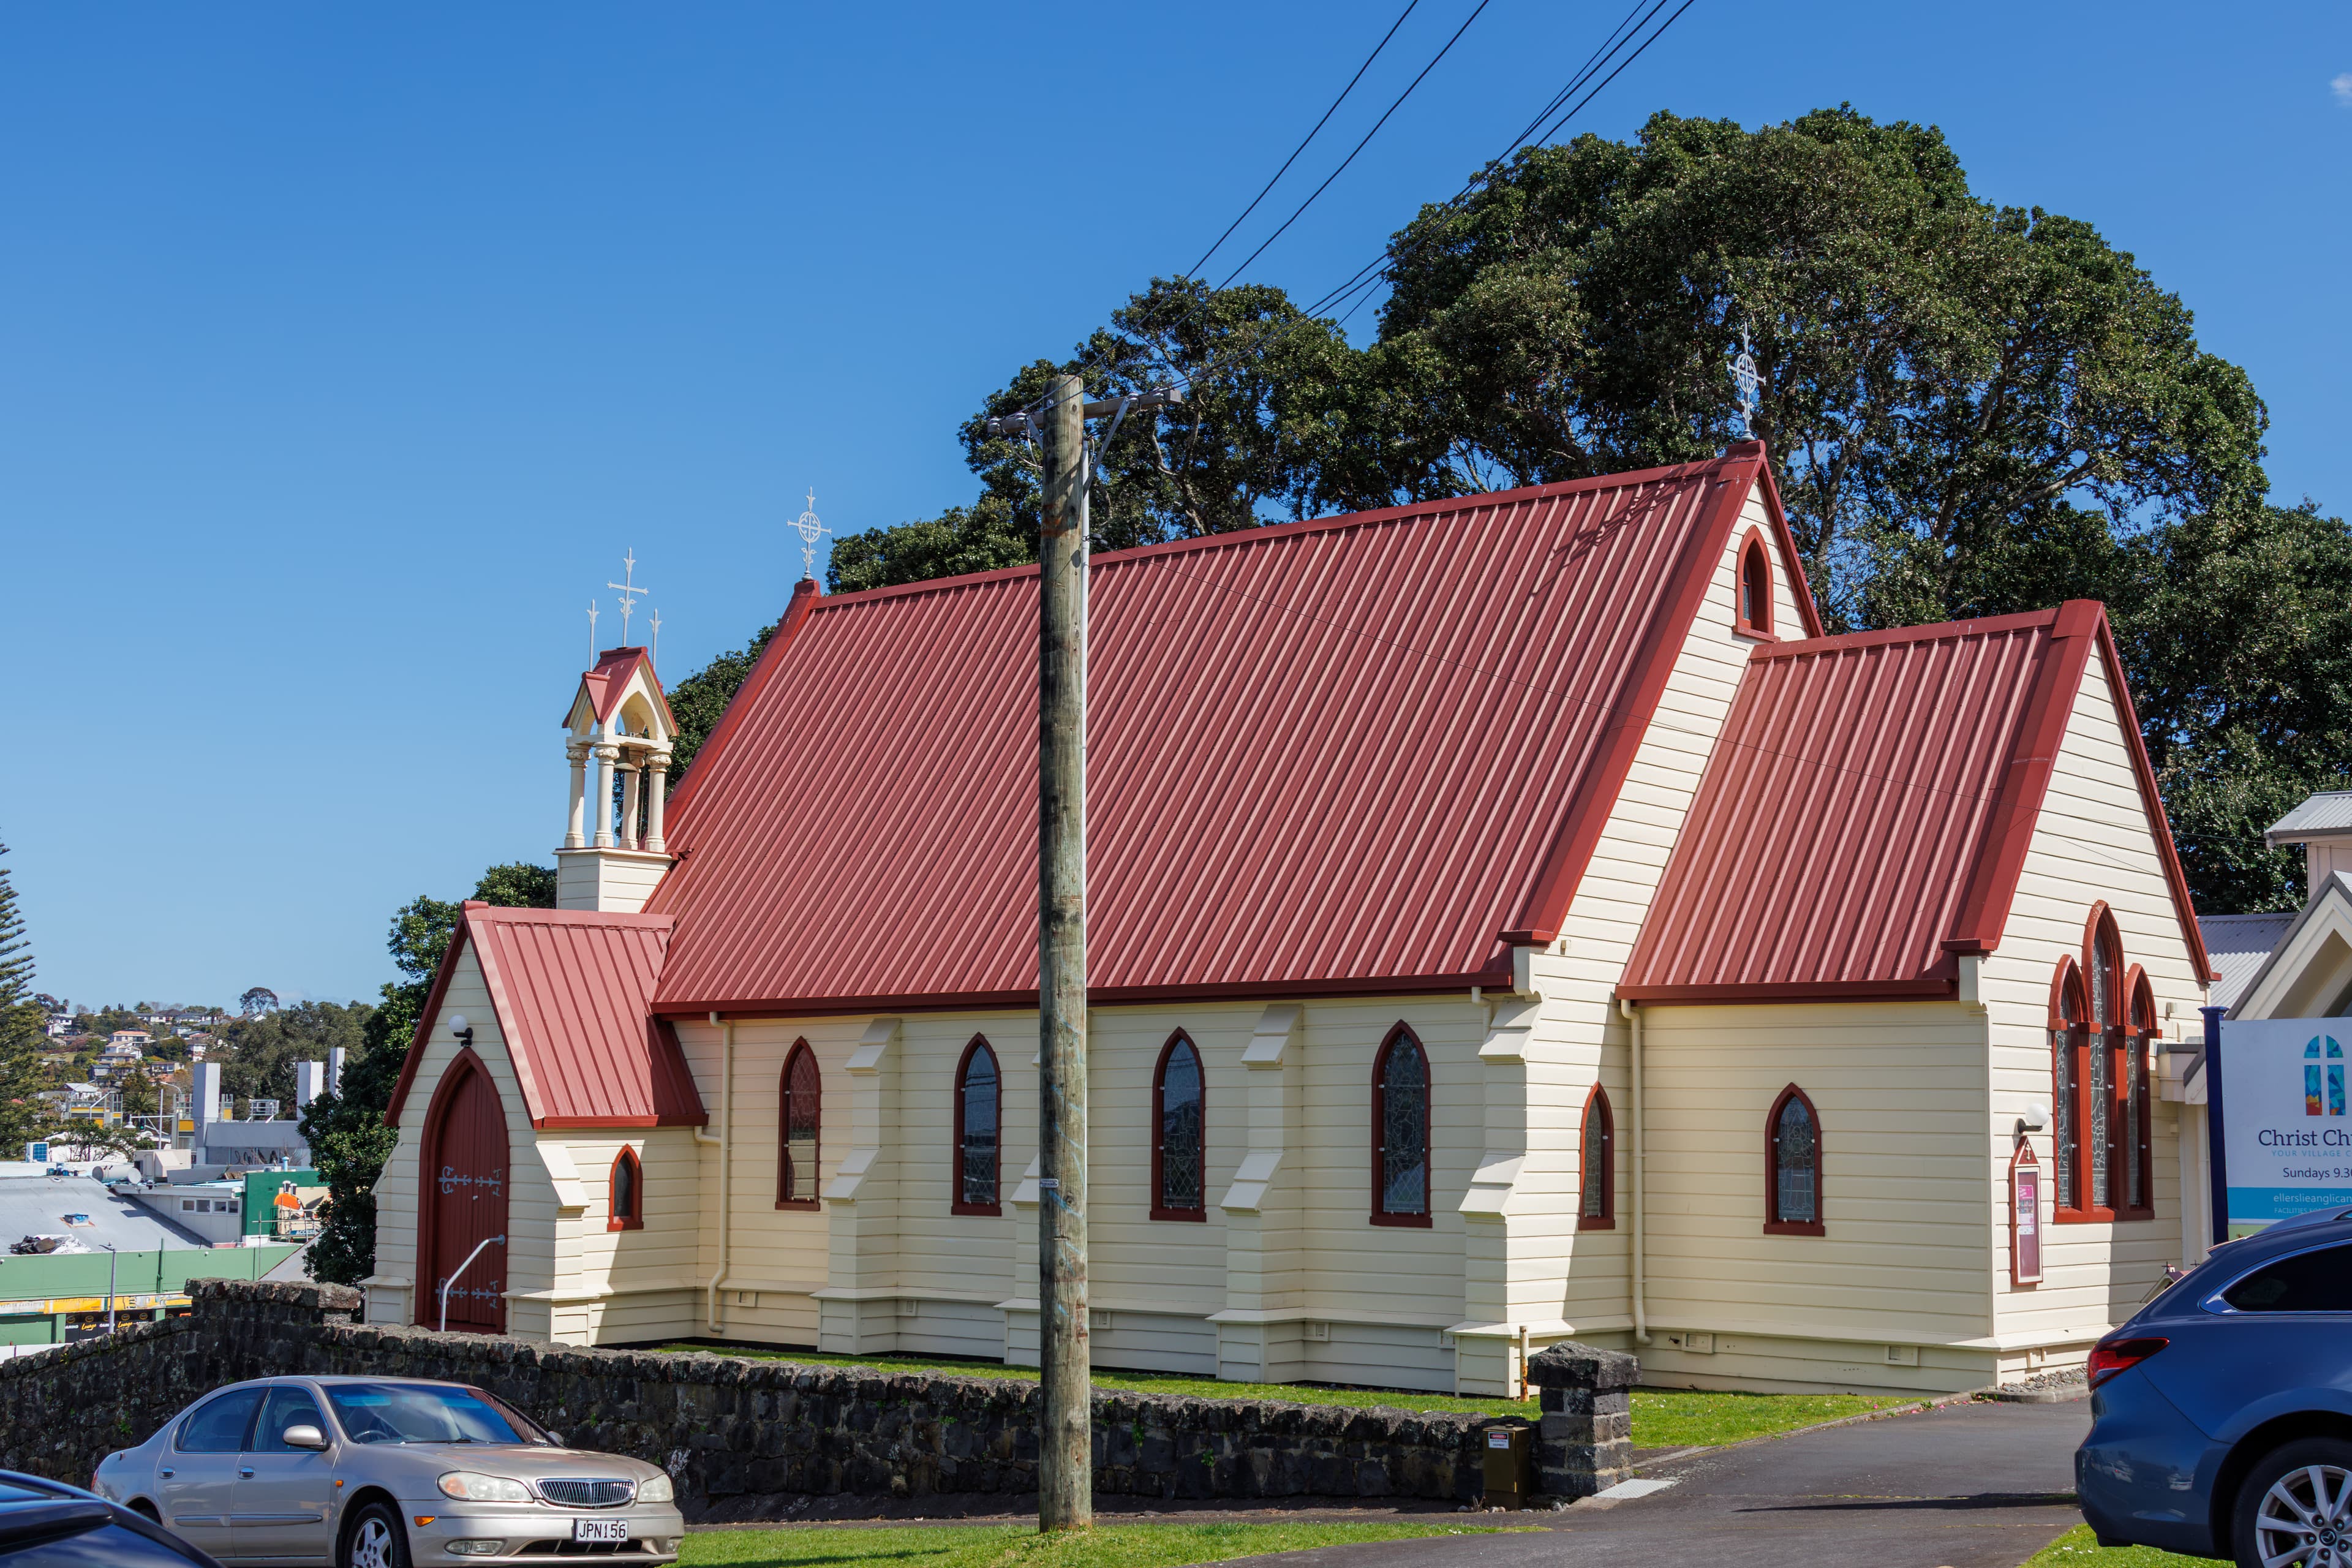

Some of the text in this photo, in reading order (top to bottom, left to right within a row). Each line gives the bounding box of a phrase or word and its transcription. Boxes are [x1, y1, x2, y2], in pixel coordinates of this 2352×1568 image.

[2258, 1129, 2352, 1146] Christ Ch
[2283, 1167, 2330, 1181] Sundays
[579, 1523, 626, 1539] JPN156
